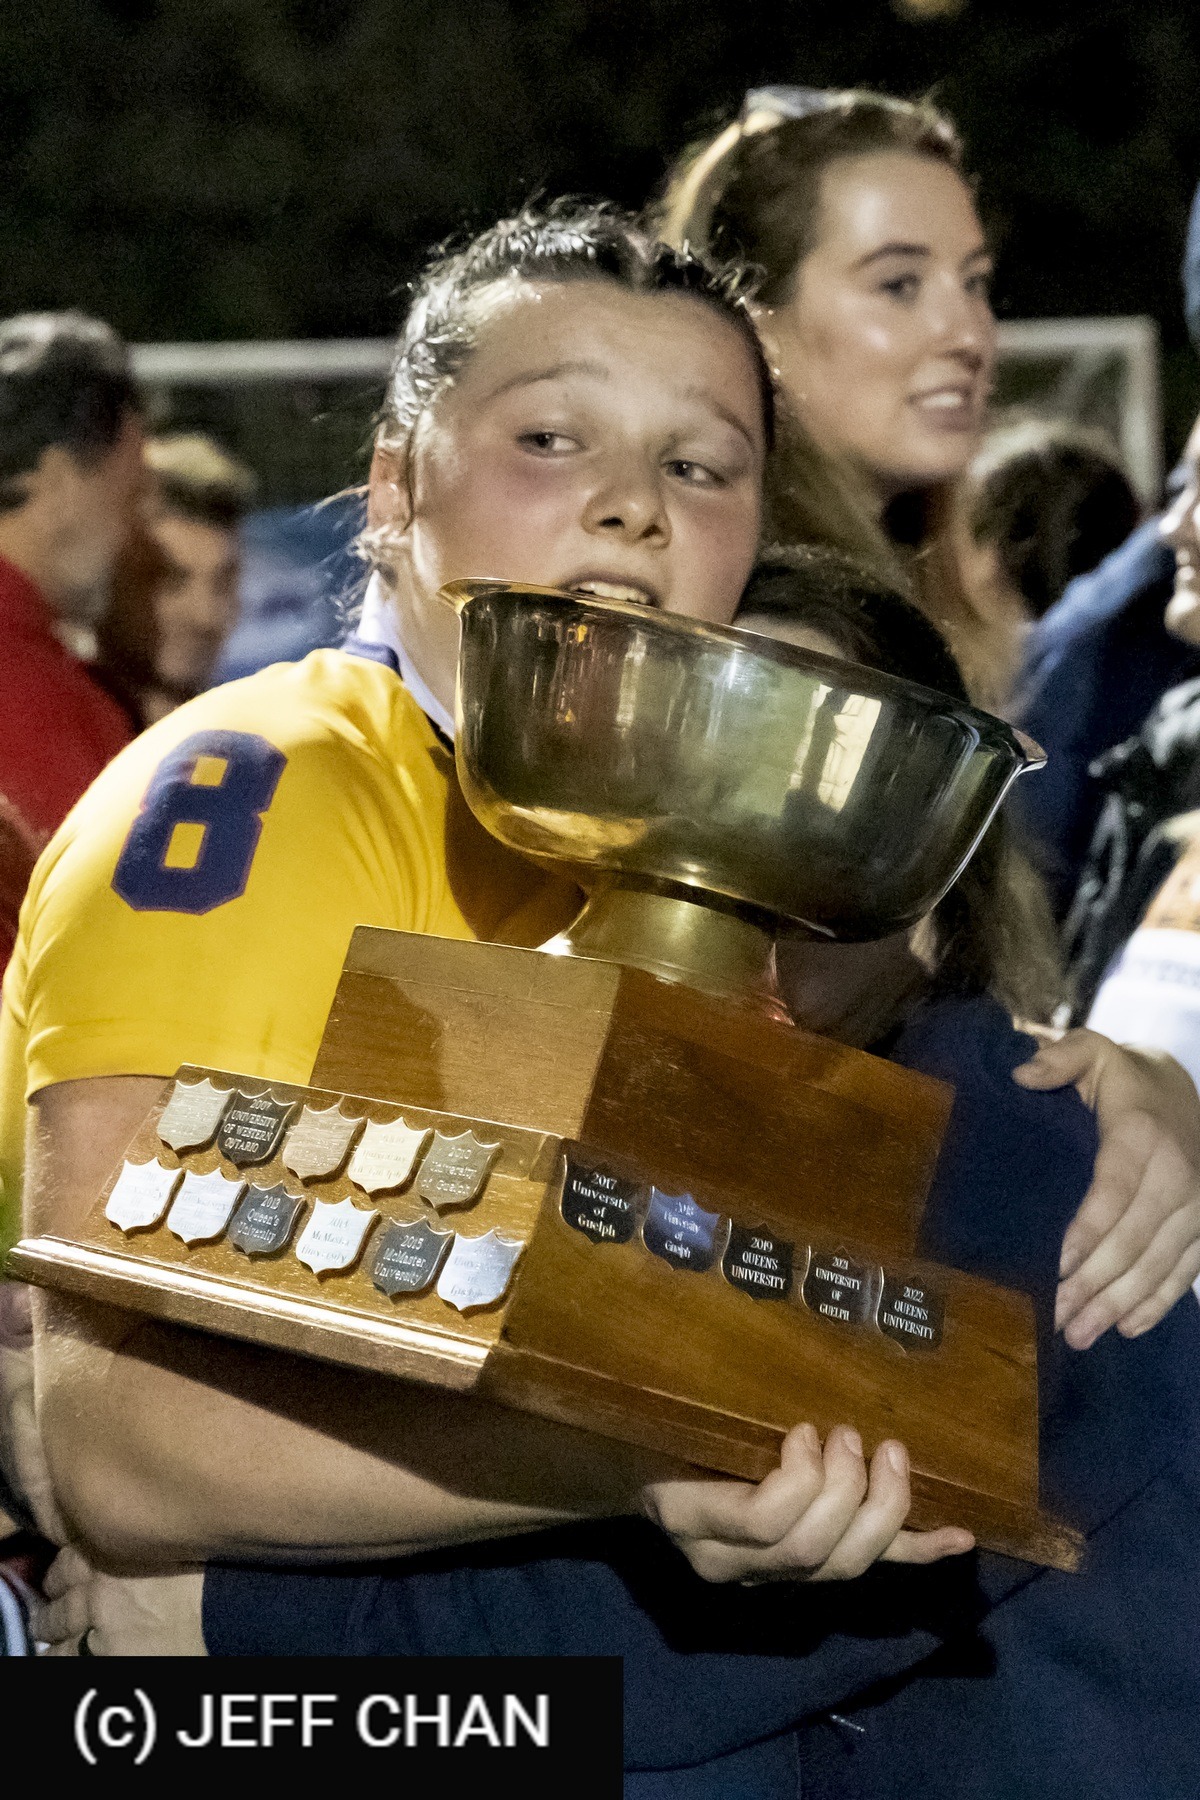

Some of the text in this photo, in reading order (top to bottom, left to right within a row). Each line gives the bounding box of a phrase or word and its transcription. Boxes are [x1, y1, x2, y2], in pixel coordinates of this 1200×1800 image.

[110, 729, 288, 916] 8
[231, 1110, 279, 1128] UNIVERSITY
[224, 1124, 274, 1141] OF WESTERN
[225, 1137, 259, 1153] ONTARIO
[591, 1172, 618, 1190] 2017
[572, 1180, 631, 1211] University
[247, 1208, 280, 1227] Queen's
[593, 1207, 606, 1218] of
[237, 1221, 276, 1243] University
[577, 1214, 616, 1238] Guelph
[401, 1235, 424, 1250] 2015
[751, 1236, 773, 1253] 2019
[383, 1247, 426, 1268] McMaster
[374, 1262, 422, 1286] University
[731, 1264, 786, 1290] UNIVERSITY
[815, 1267, 862, 1291] UNIVERSITY
[832, 1290, 842, 1301] OF
[903, 1286, 924, 1303] 2022
[819, 1303, 850, 1321] GUELPH
[883, 1312, 935, 1340] UNIVERSITY
